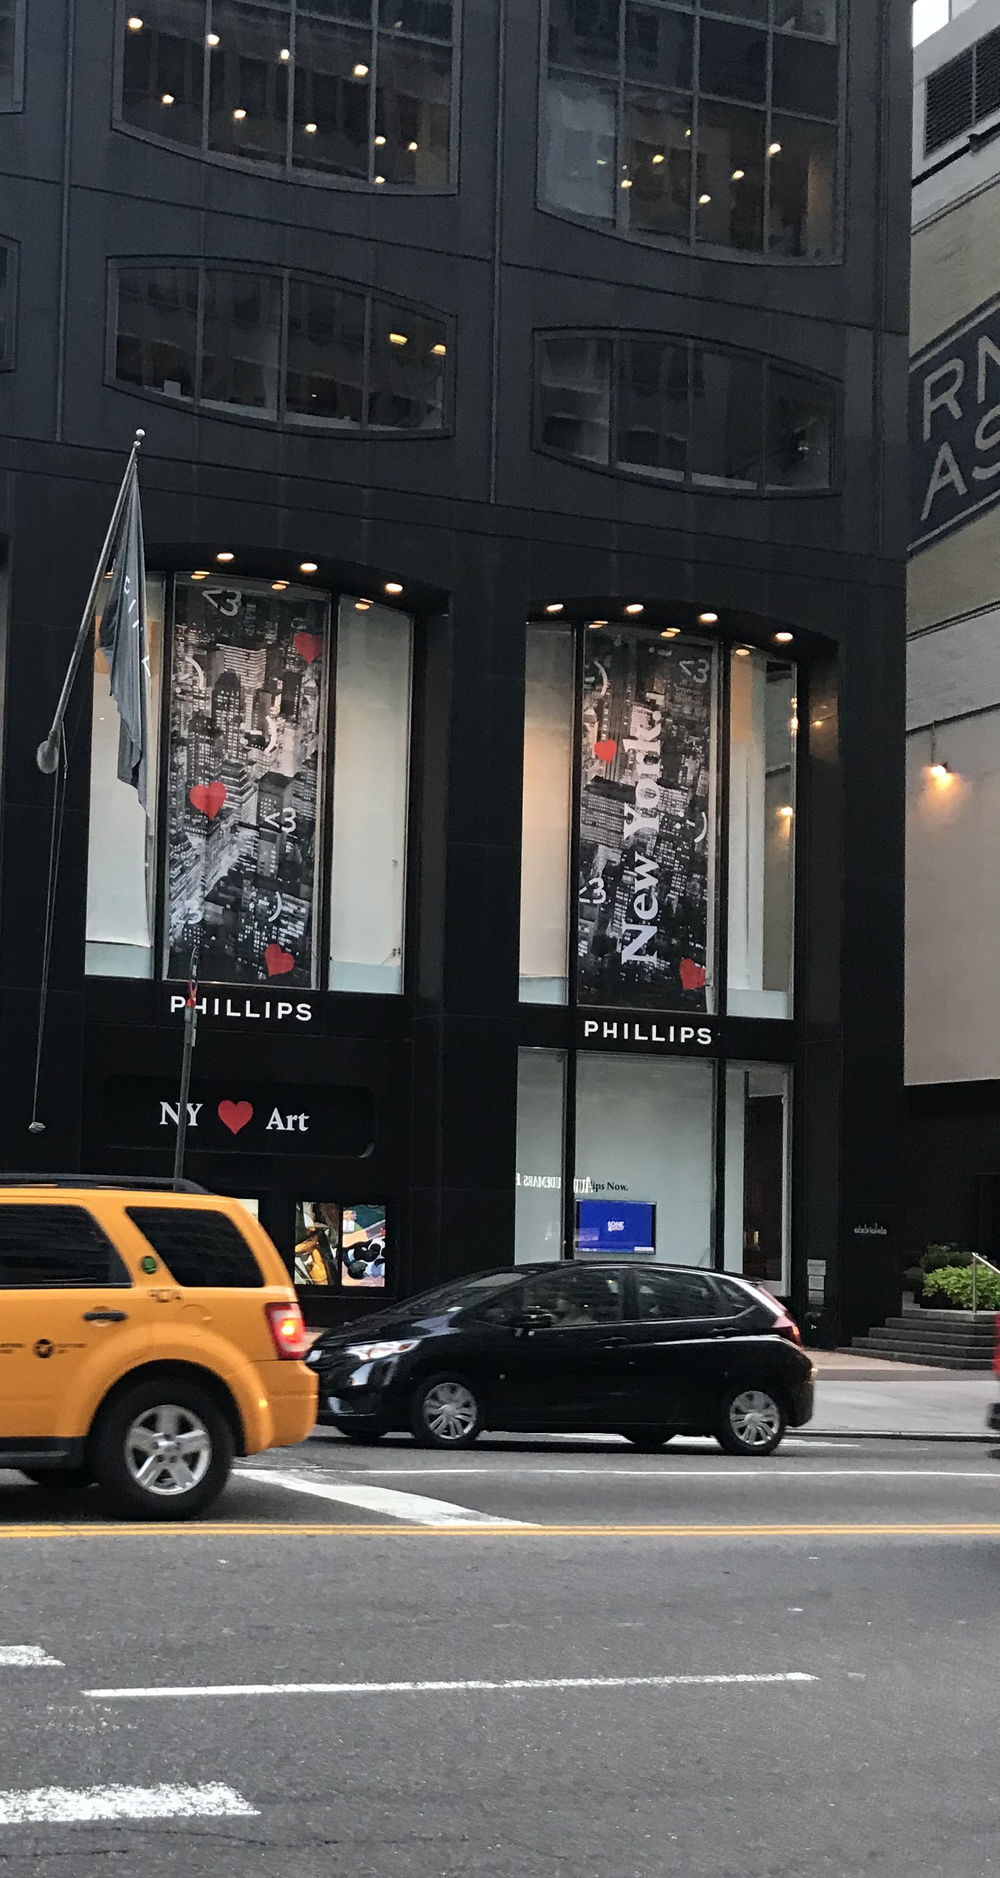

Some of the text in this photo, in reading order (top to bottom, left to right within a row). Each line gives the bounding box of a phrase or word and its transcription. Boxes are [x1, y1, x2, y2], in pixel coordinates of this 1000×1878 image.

[621, 853, 659, 965] New
[170, 995, 312, 1022] PHILLIPS
[584, 1020, 712, 1045] PHILLIPS
[159, 1101, 310, 1132] NY Art
